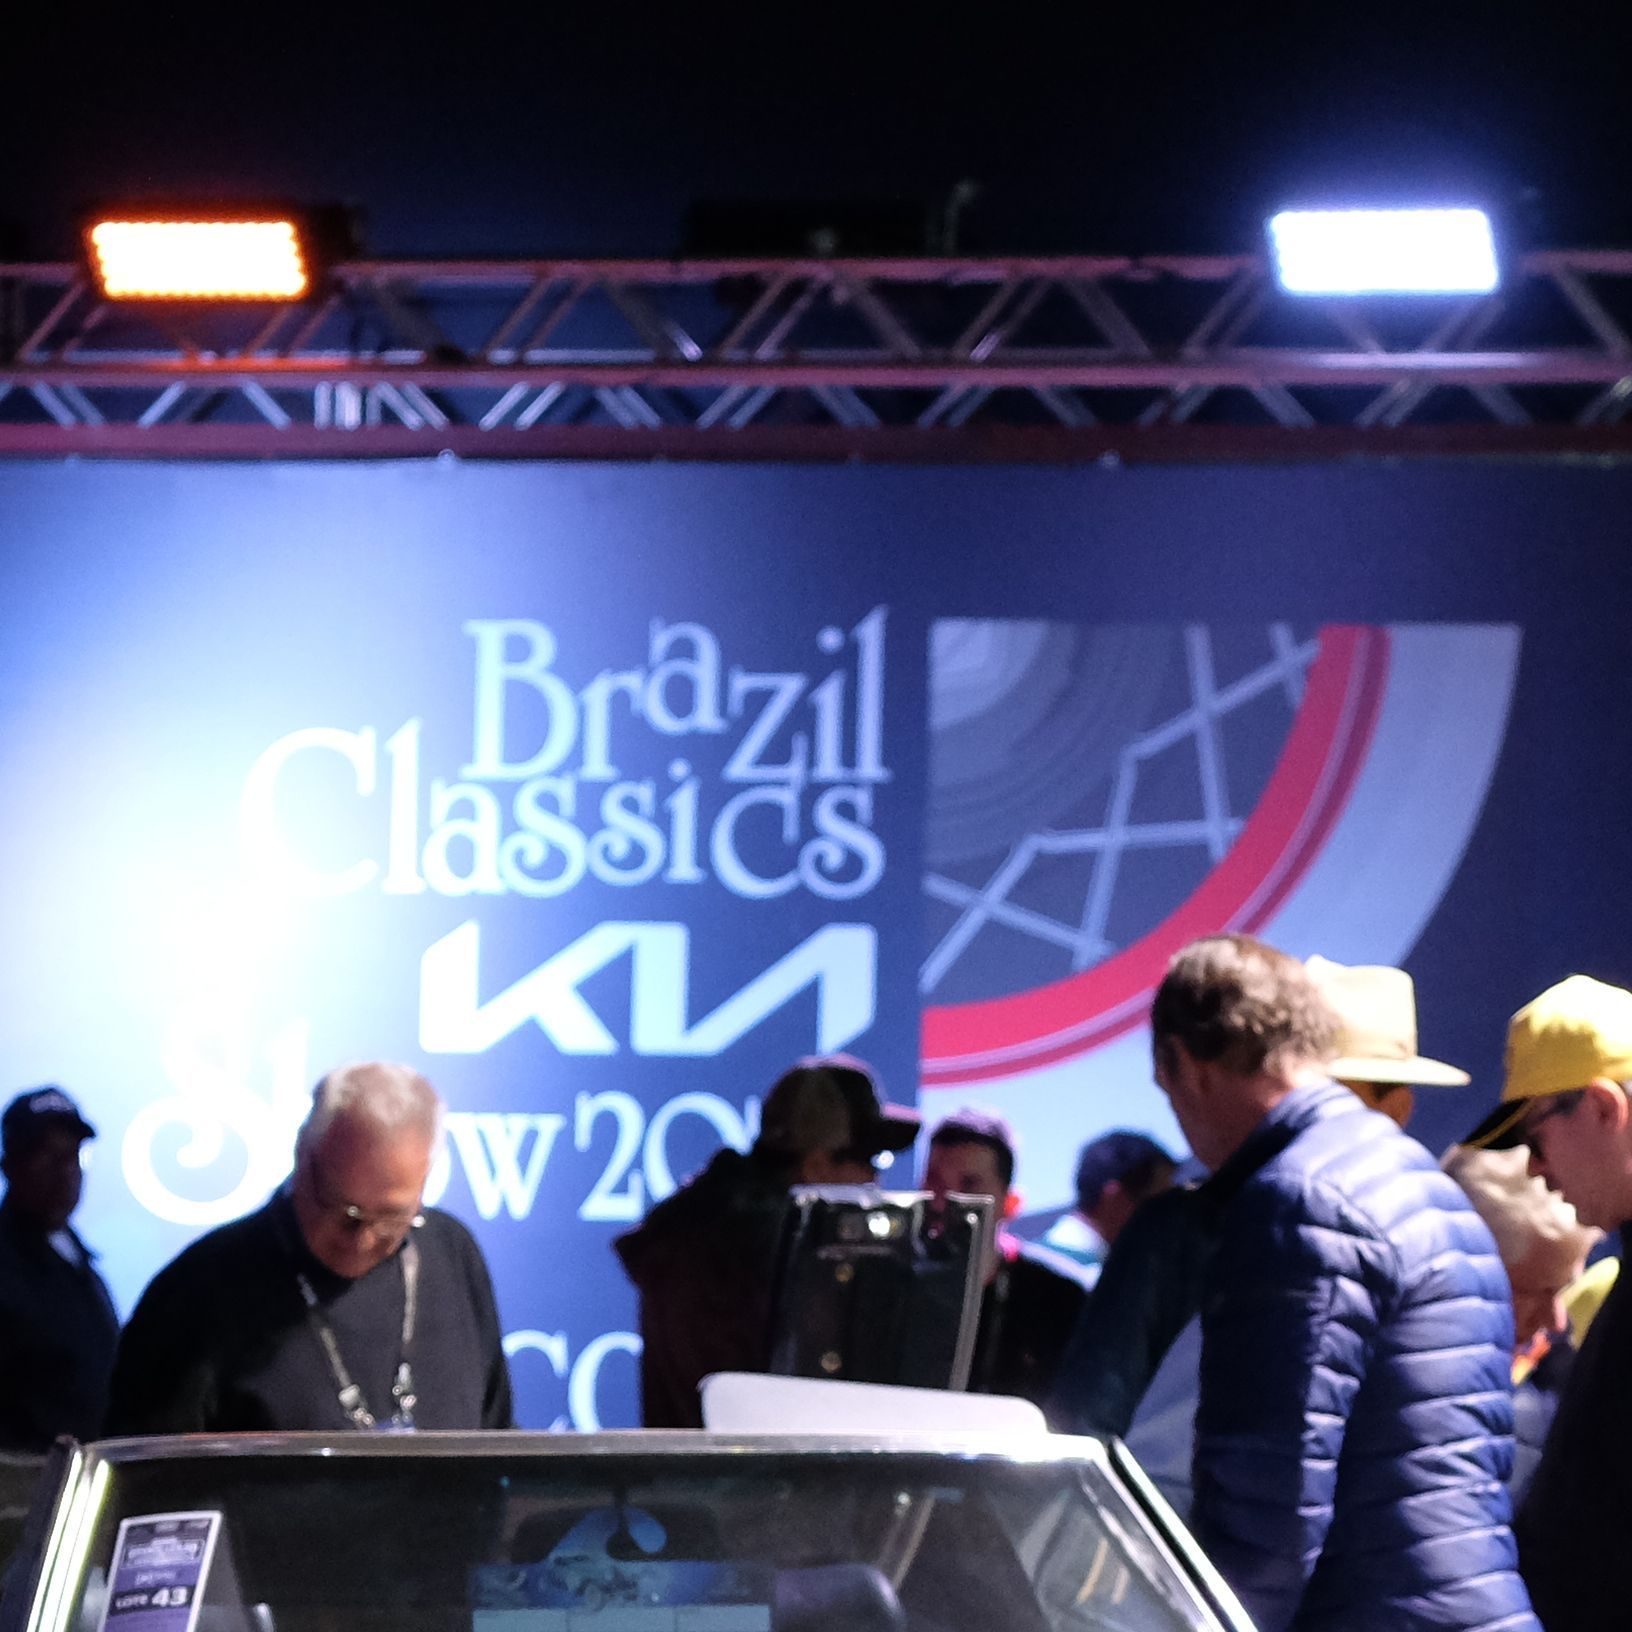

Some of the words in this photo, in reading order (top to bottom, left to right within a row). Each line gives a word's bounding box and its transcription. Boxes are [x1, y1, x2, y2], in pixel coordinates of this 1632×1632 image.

[462, 604, 891, 783] Brazil
[238, 716, 887, 899] Classics
[418, 919, 878, 1058] KIA
[151, 1586, 188, 1607] 43
